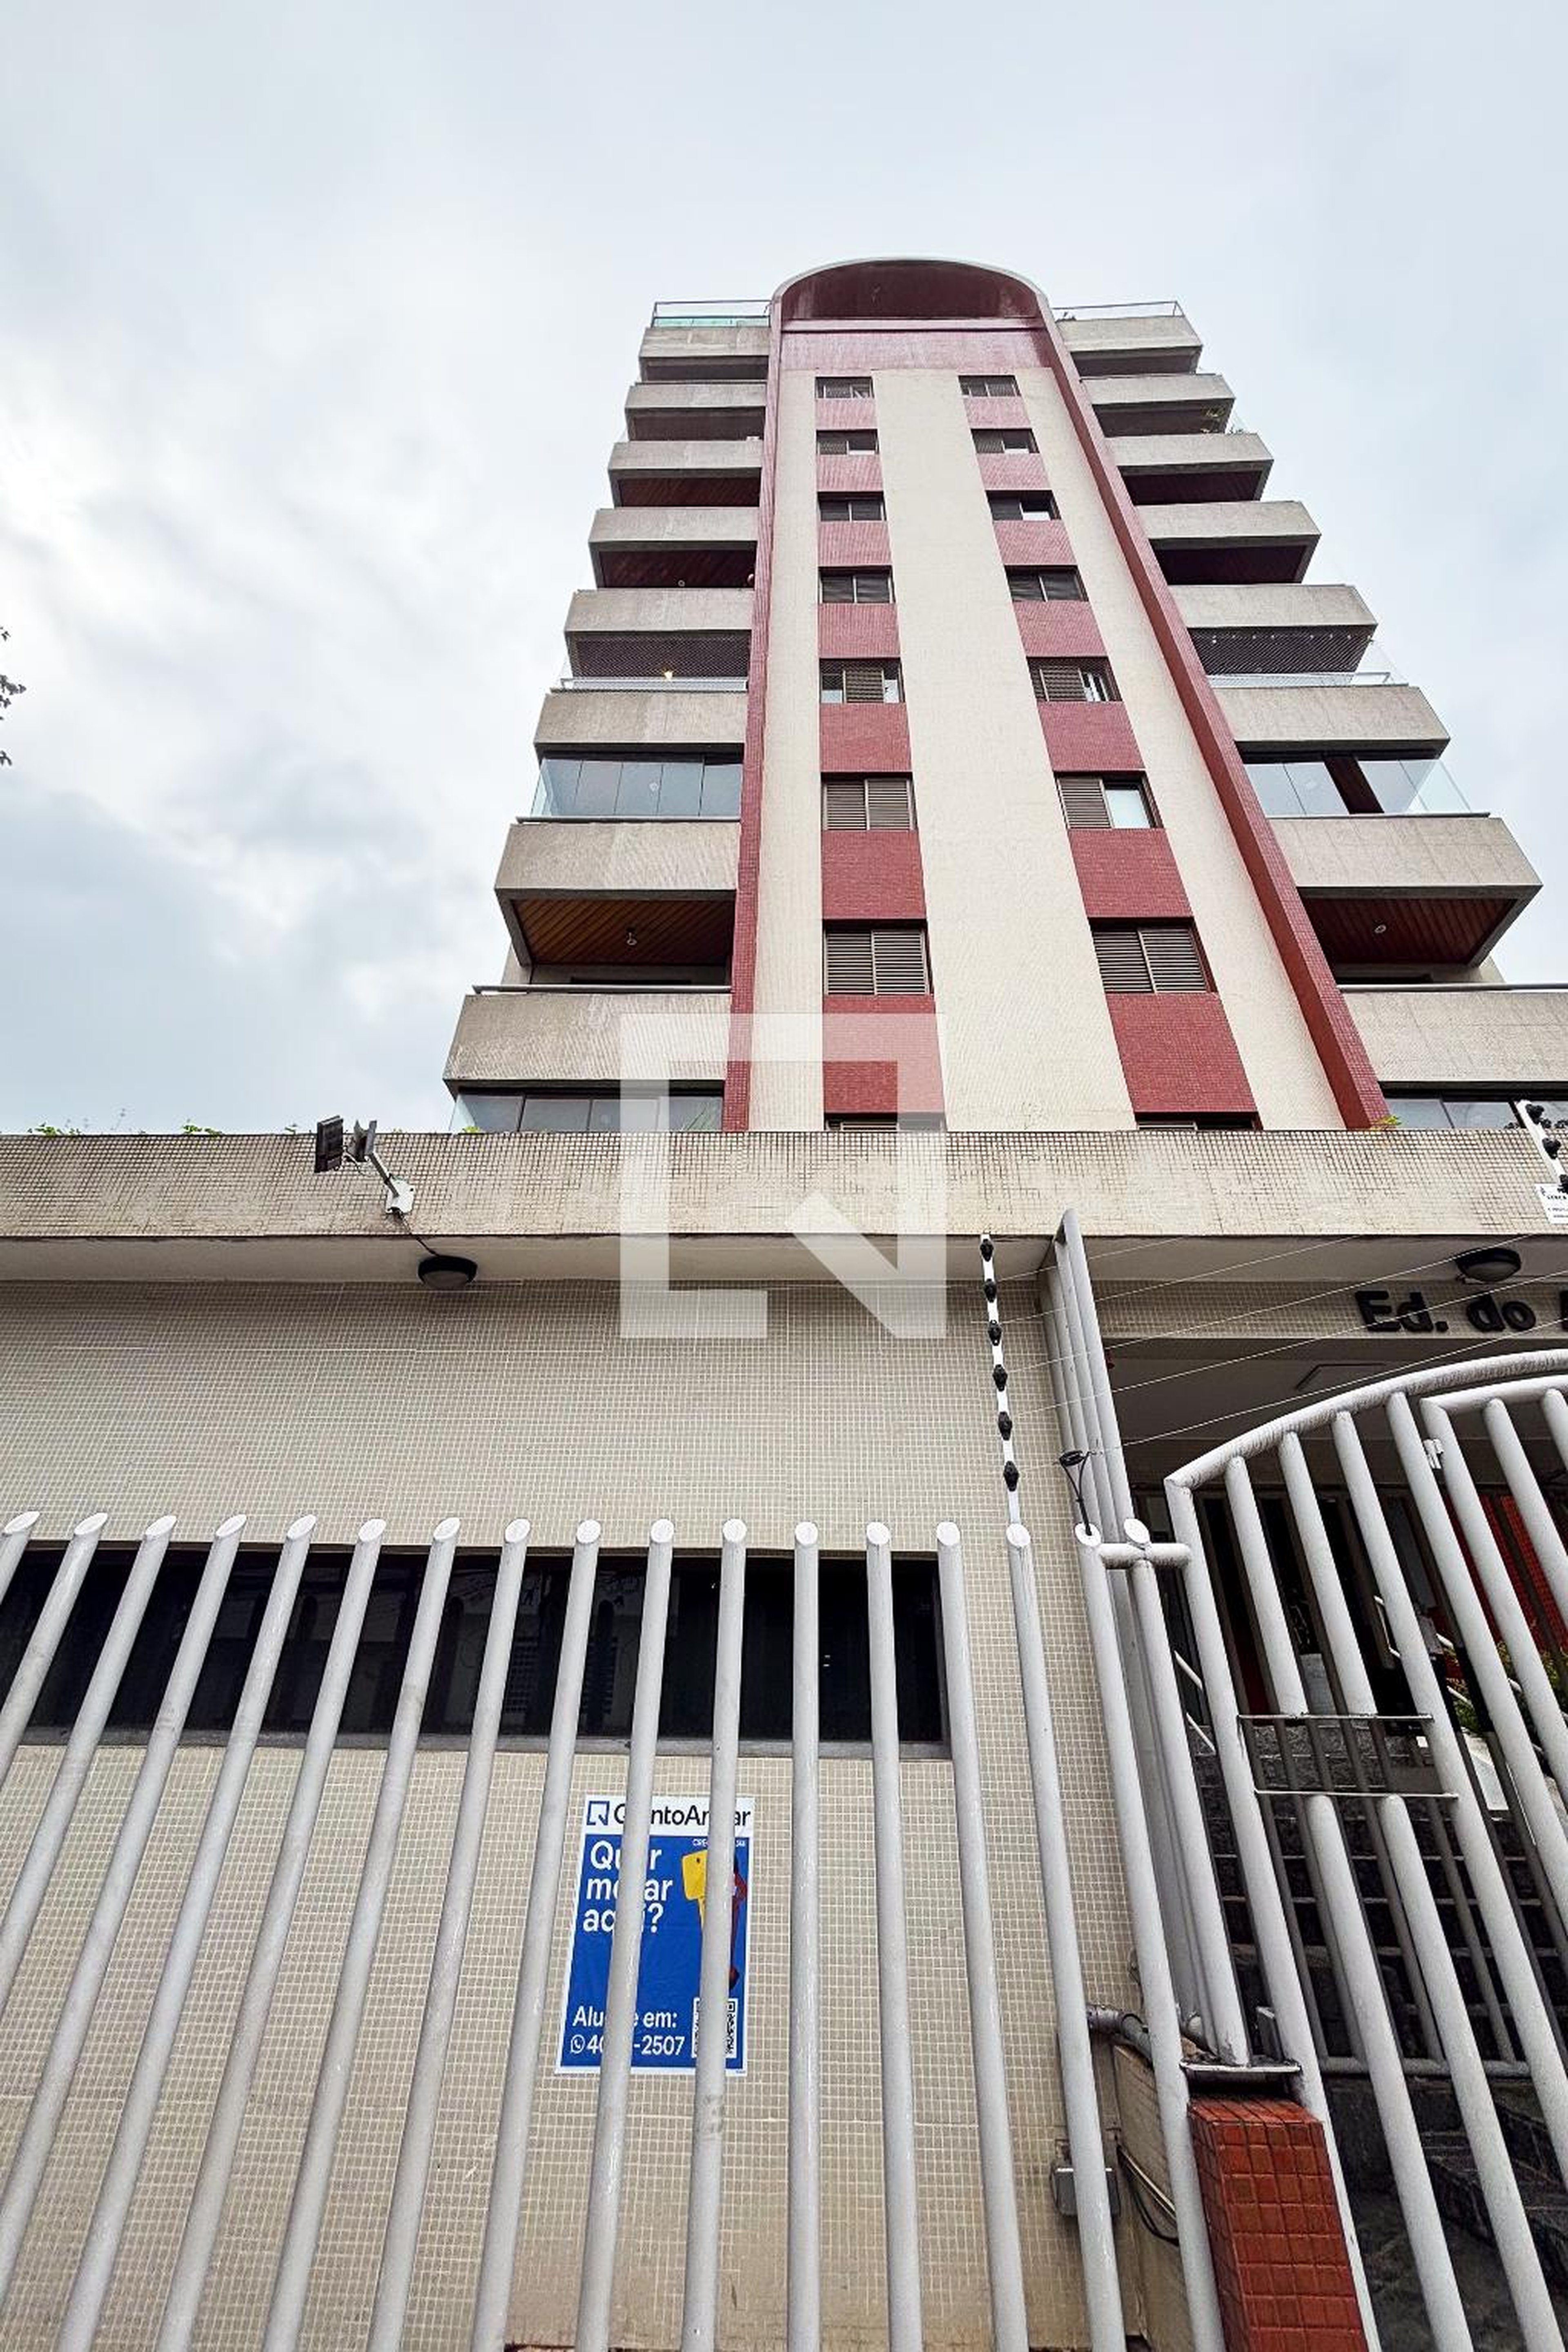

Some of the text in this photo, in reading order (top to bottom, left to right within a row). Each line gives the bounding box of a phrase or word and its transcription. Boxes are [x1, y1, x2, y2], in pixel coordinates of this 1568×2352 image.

[1355, 1291, 1449, 1332] Ed.
[1467, 1292, 1536, 1332] do
[590, 1840, 662, 1870] Qr
[586, 1878, 673, 1901] mar
[643, 2011, 677, 2028] em:
[587, 2035, 685, 2056] 4-2507
